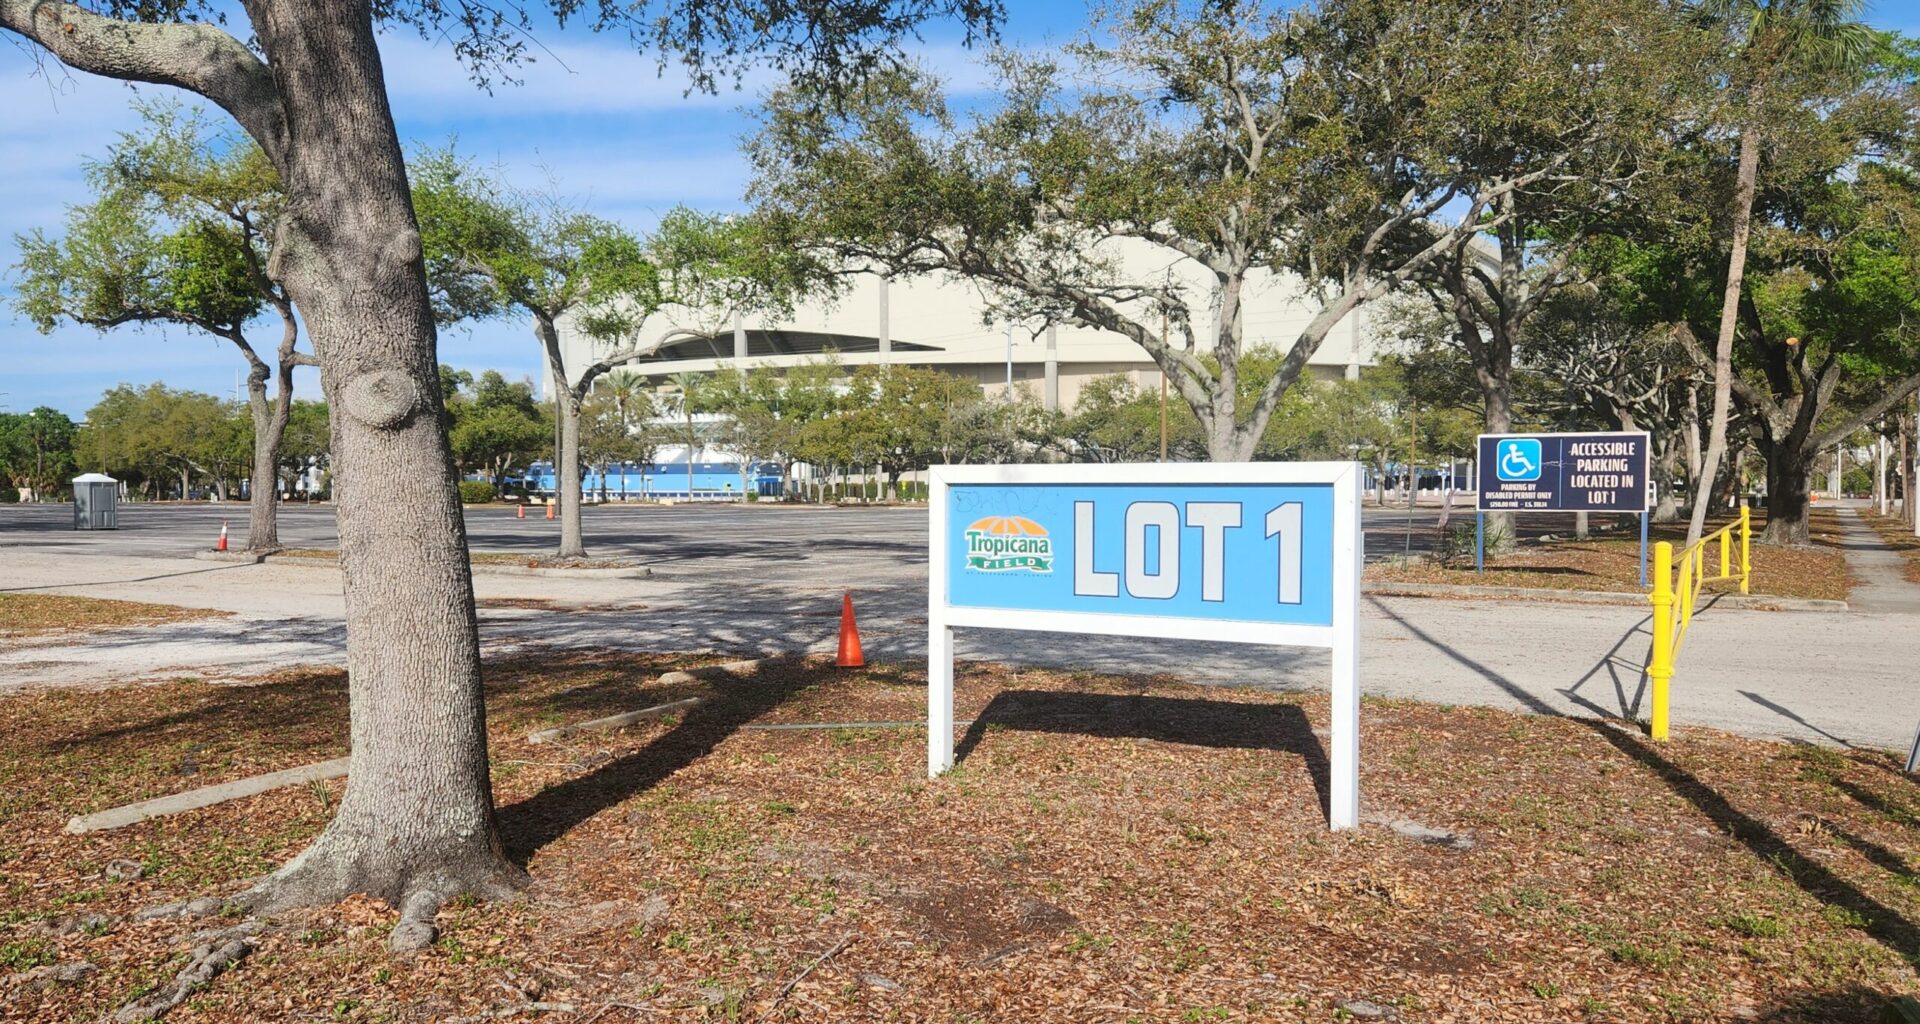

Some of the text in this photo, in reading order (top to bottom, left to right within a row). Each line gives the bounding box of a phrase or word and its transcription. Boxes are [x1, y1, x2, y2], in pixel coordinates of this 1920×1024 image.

[1570, 442, 1636, 456] ACCESSIBLE
[1577, 458, 1628, 472] PARKING
[1500, 483, 1537, 491] PARKING BY
[1571, 474, 1634, 488] LOCATED IN
[1485, 491, 1552, 499] DISABLED PERMIT ONLY
[1588, 490, 1616, 504] LOT 1
[966, 531, 1049, 556] Tropicana
[1073, 500, 1304, 606] LOT 1
[983, 557, 1036, 569] FIELD
